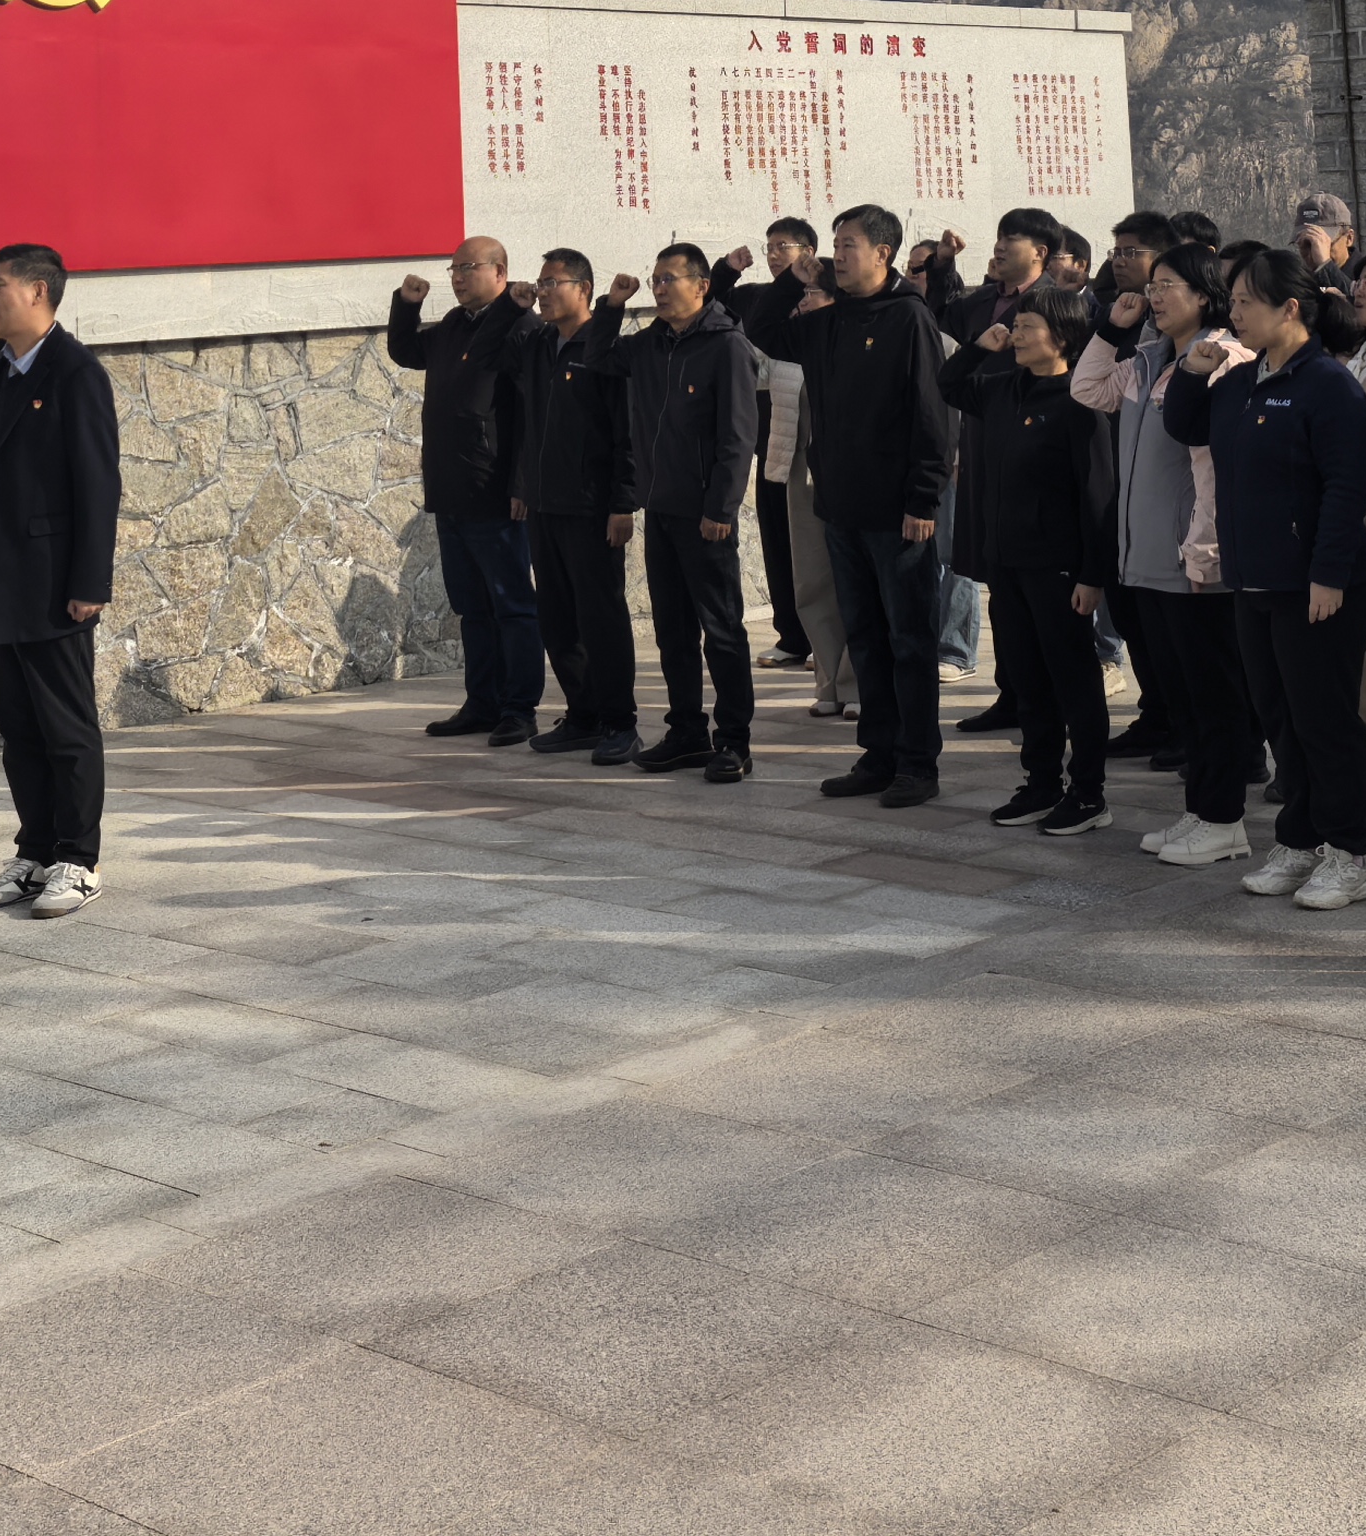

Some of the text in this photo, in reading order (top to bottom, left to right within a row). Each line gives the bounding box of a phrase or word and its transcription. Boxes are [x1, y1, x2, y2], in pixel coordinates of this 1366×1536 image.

[747, 29, 927, 58] 入党誓词的演变
